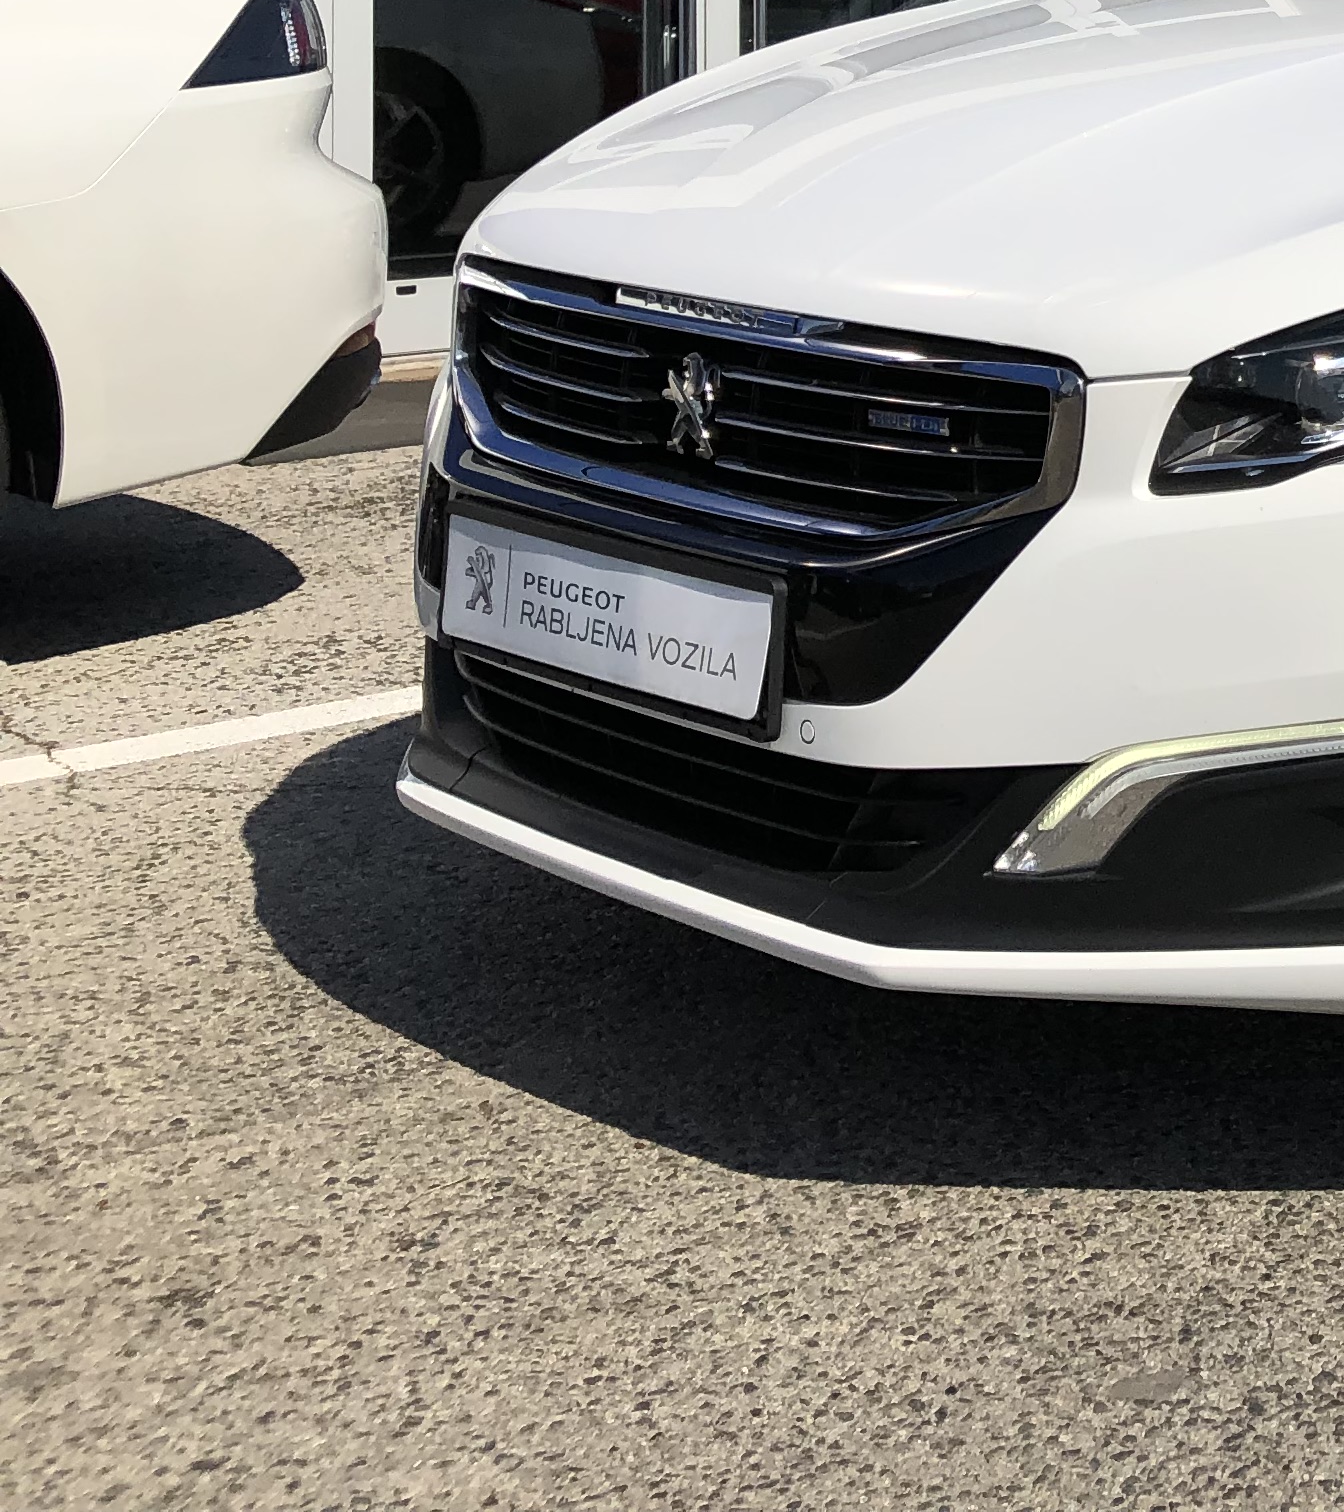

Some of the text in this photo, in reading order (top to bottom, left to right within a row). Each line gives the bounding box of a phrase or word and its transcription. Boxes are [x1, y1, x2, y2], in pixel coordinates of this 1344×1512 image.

[523, 571, 625, 614] PEUGEOT
[520, 599, 738, 682] RABLJENA VOZILA
